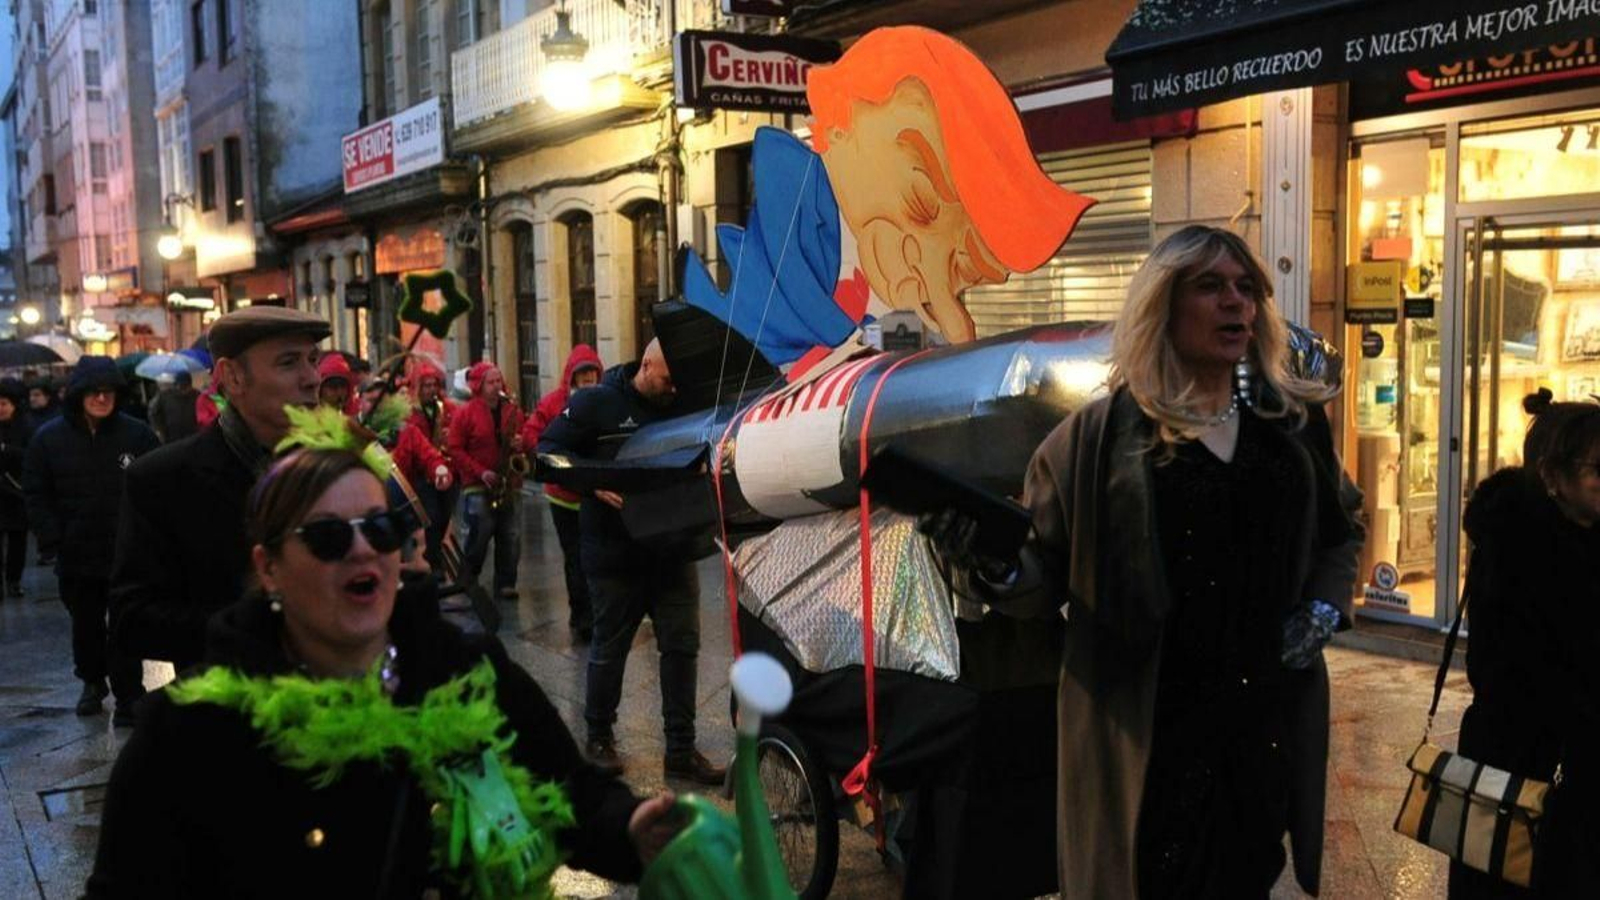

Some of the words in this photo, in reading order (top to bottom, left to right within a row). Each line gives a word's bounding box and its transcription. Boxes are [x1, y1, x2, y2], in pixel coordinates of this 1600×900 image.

[1345, 38, 1365, 63] ES
[1369, 19, 1458, 59] NUESTRA
[1465, 4, 1538, 40] MEJOR
[1131, 83, 1149, 102] TU
[1152, 73, 1181, 100] MÁS
[1184, 66, 1229, 94] BELLO
[1233, 47, 1323, 83] RECUERDO
[344, 139, 358, 170] SE
[359, 126, 392, 164] VENDE
